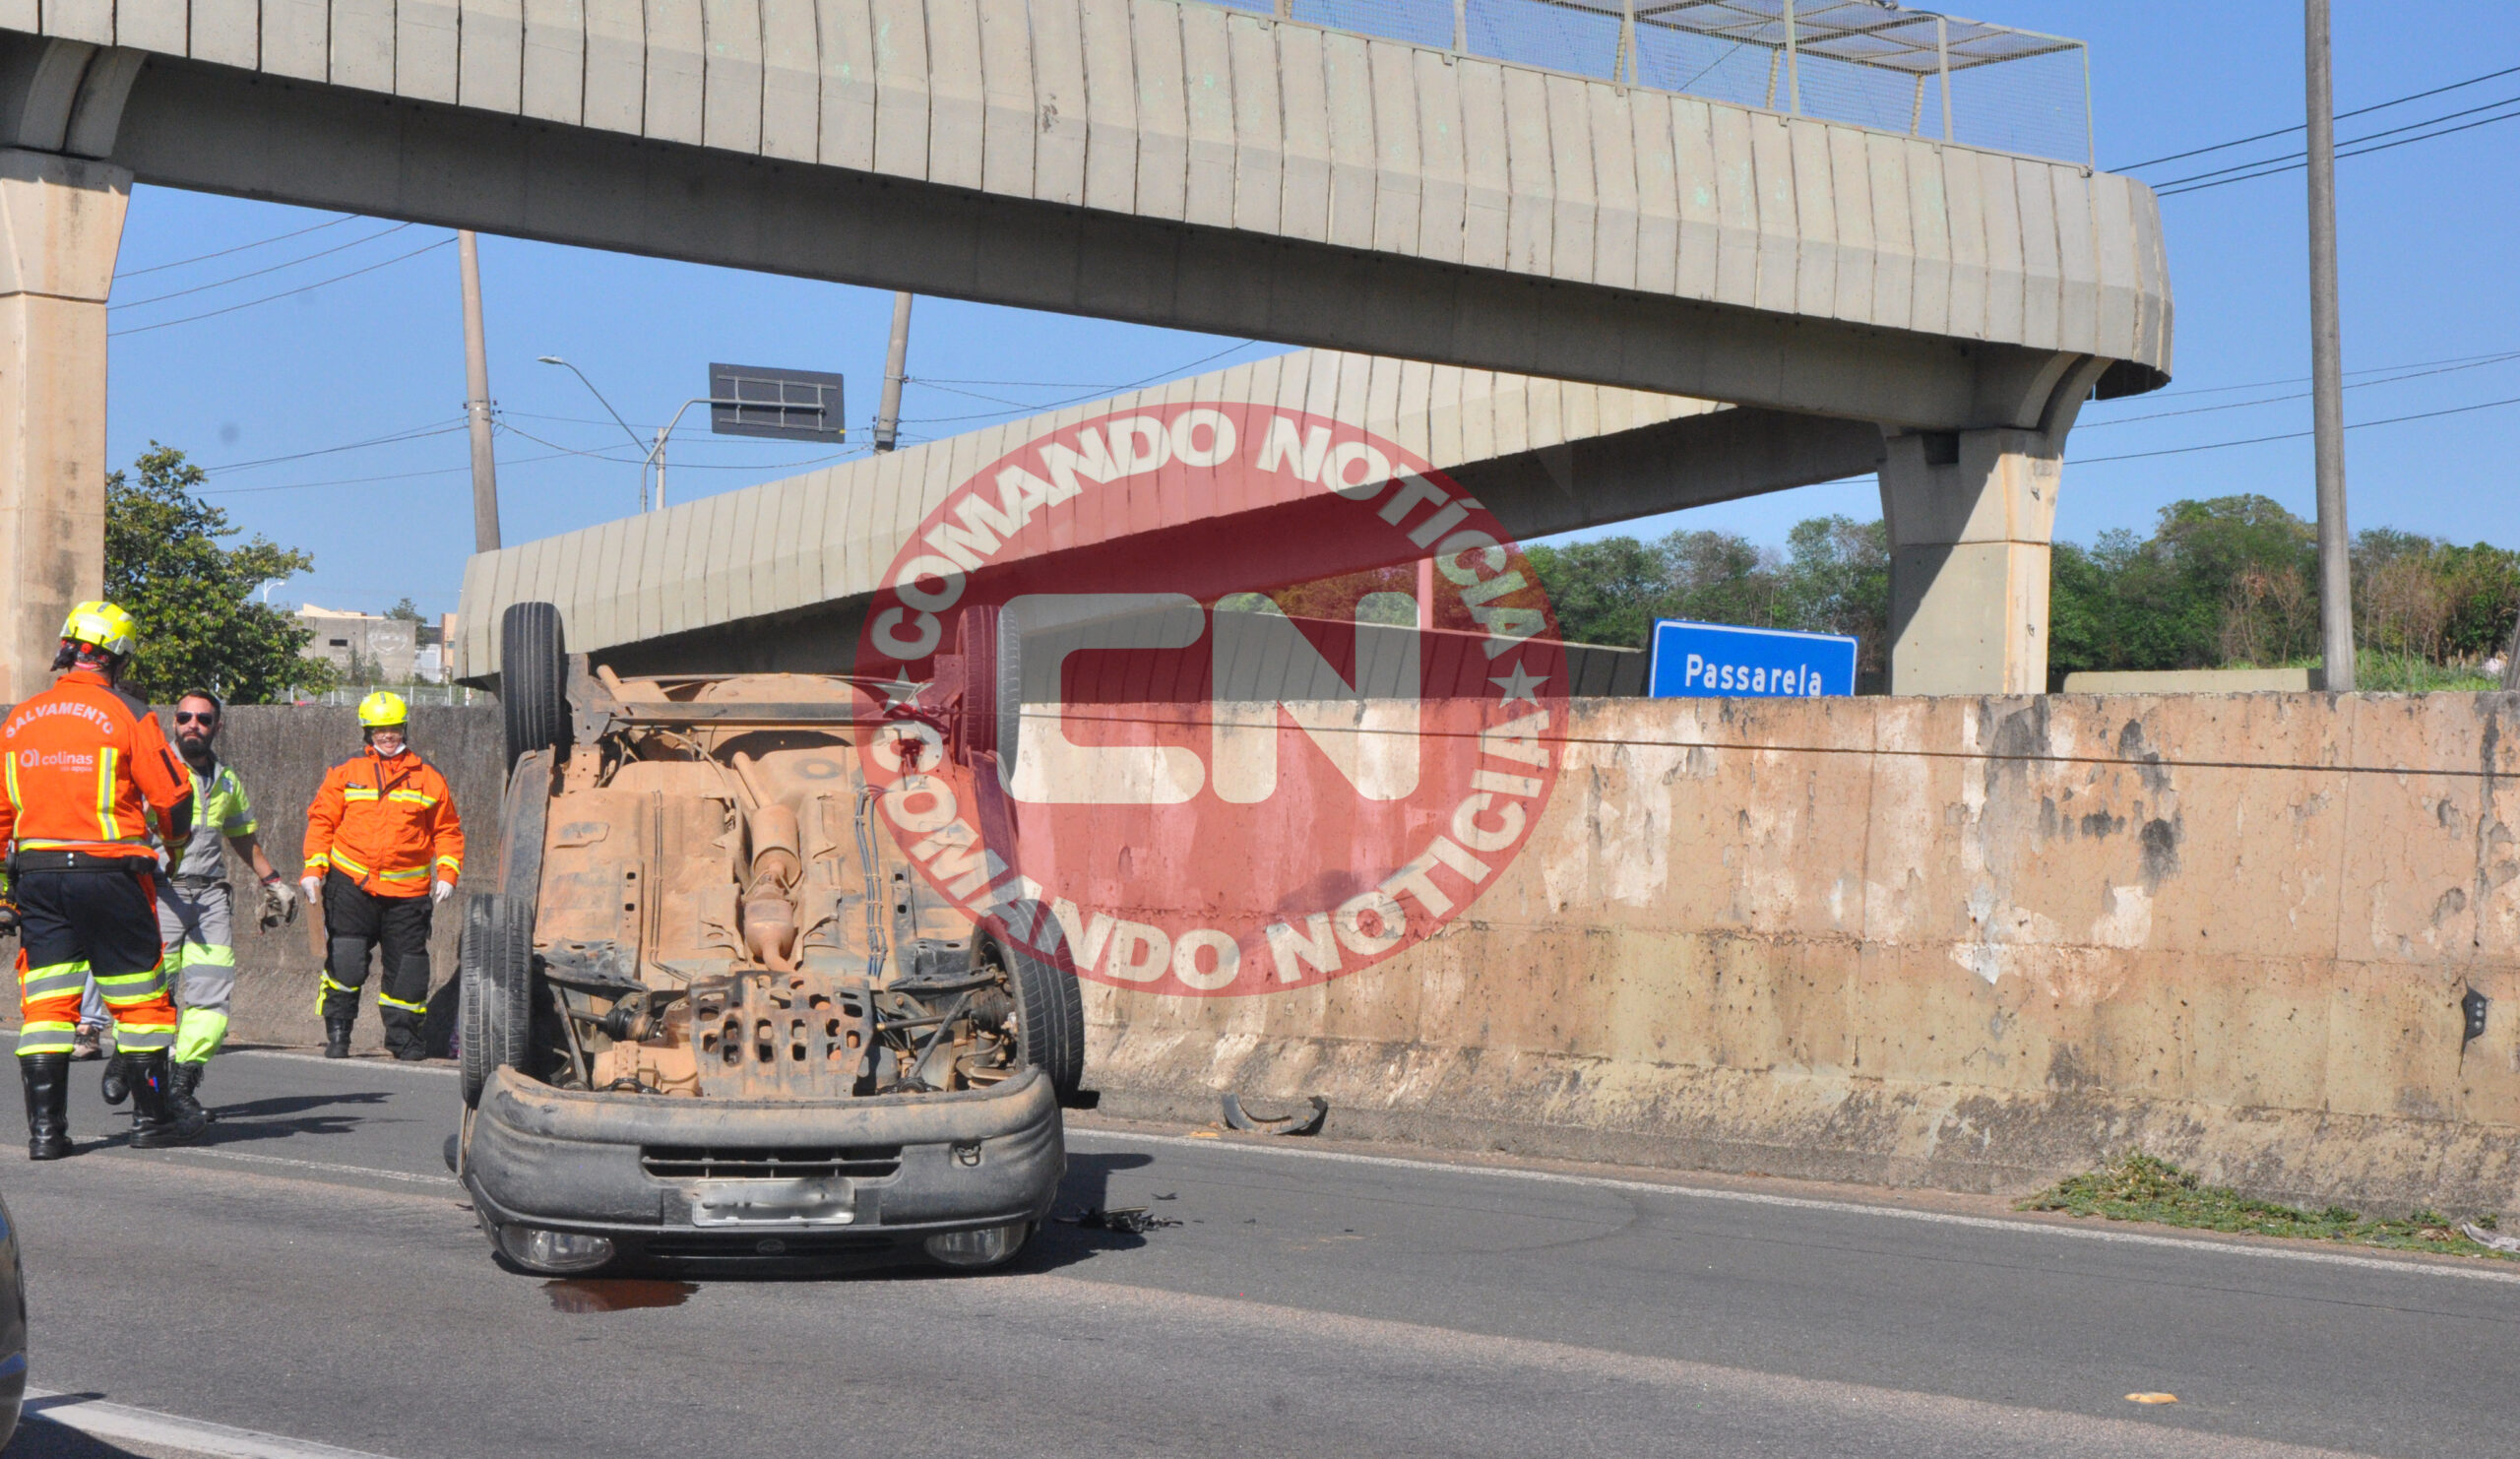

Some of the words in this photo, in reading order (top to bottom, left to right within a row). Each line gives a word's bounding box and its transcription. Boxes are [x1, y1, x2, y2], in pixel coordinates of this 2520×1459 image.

[1684, 654, 1822, 696] Passarela
[6, 702, 113, 738] SALVAMENTO
[41, 751, 94, 765] colinas
